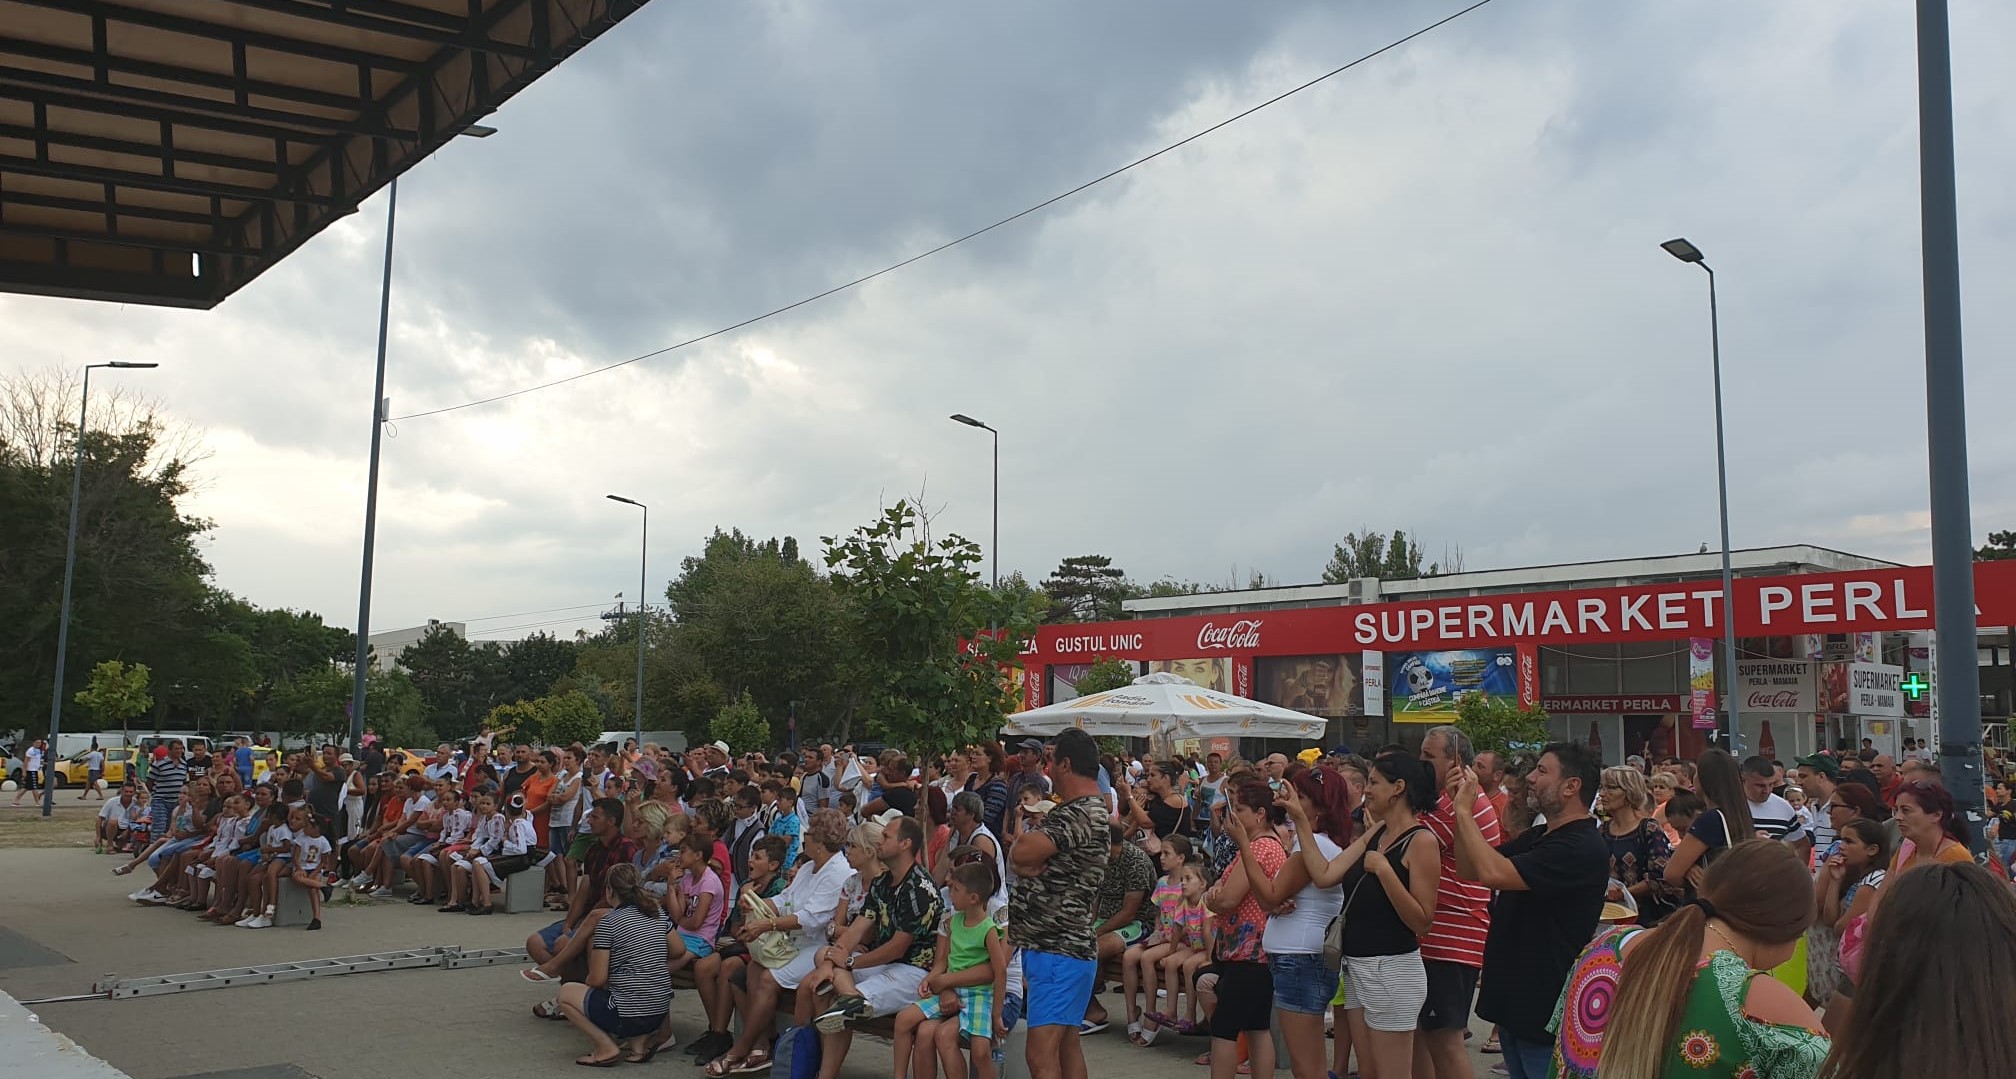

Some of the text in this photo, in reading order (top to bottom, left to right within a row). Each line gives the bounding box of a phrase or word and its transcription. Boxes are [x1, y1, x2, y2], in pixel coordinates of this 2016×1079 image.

[1353, 579, 1982, 645] SUPERMARKET PERL
[1055, 636, 1107, 653] GUSTUL
[1110, 634, 1143, 651] UNIC
[1197, 620, 1263, 650] Coca-Cola
[1738, 663, 1808, 676] SUPERMARKET
[1748, 677, 1769, 686] PERLA
[1773, 677, 1798, 685] MAMAIA
[1853, 670, 1900, 692] SUPERMARKET
[1543, 699, 1672, 711] ERMARKET PERLA
[1860, 694, 1874, 707] PERLA
[1877, 695, 1894, 708] MAMAIA
[1930, 649, 1939, 746] FARMACIE
